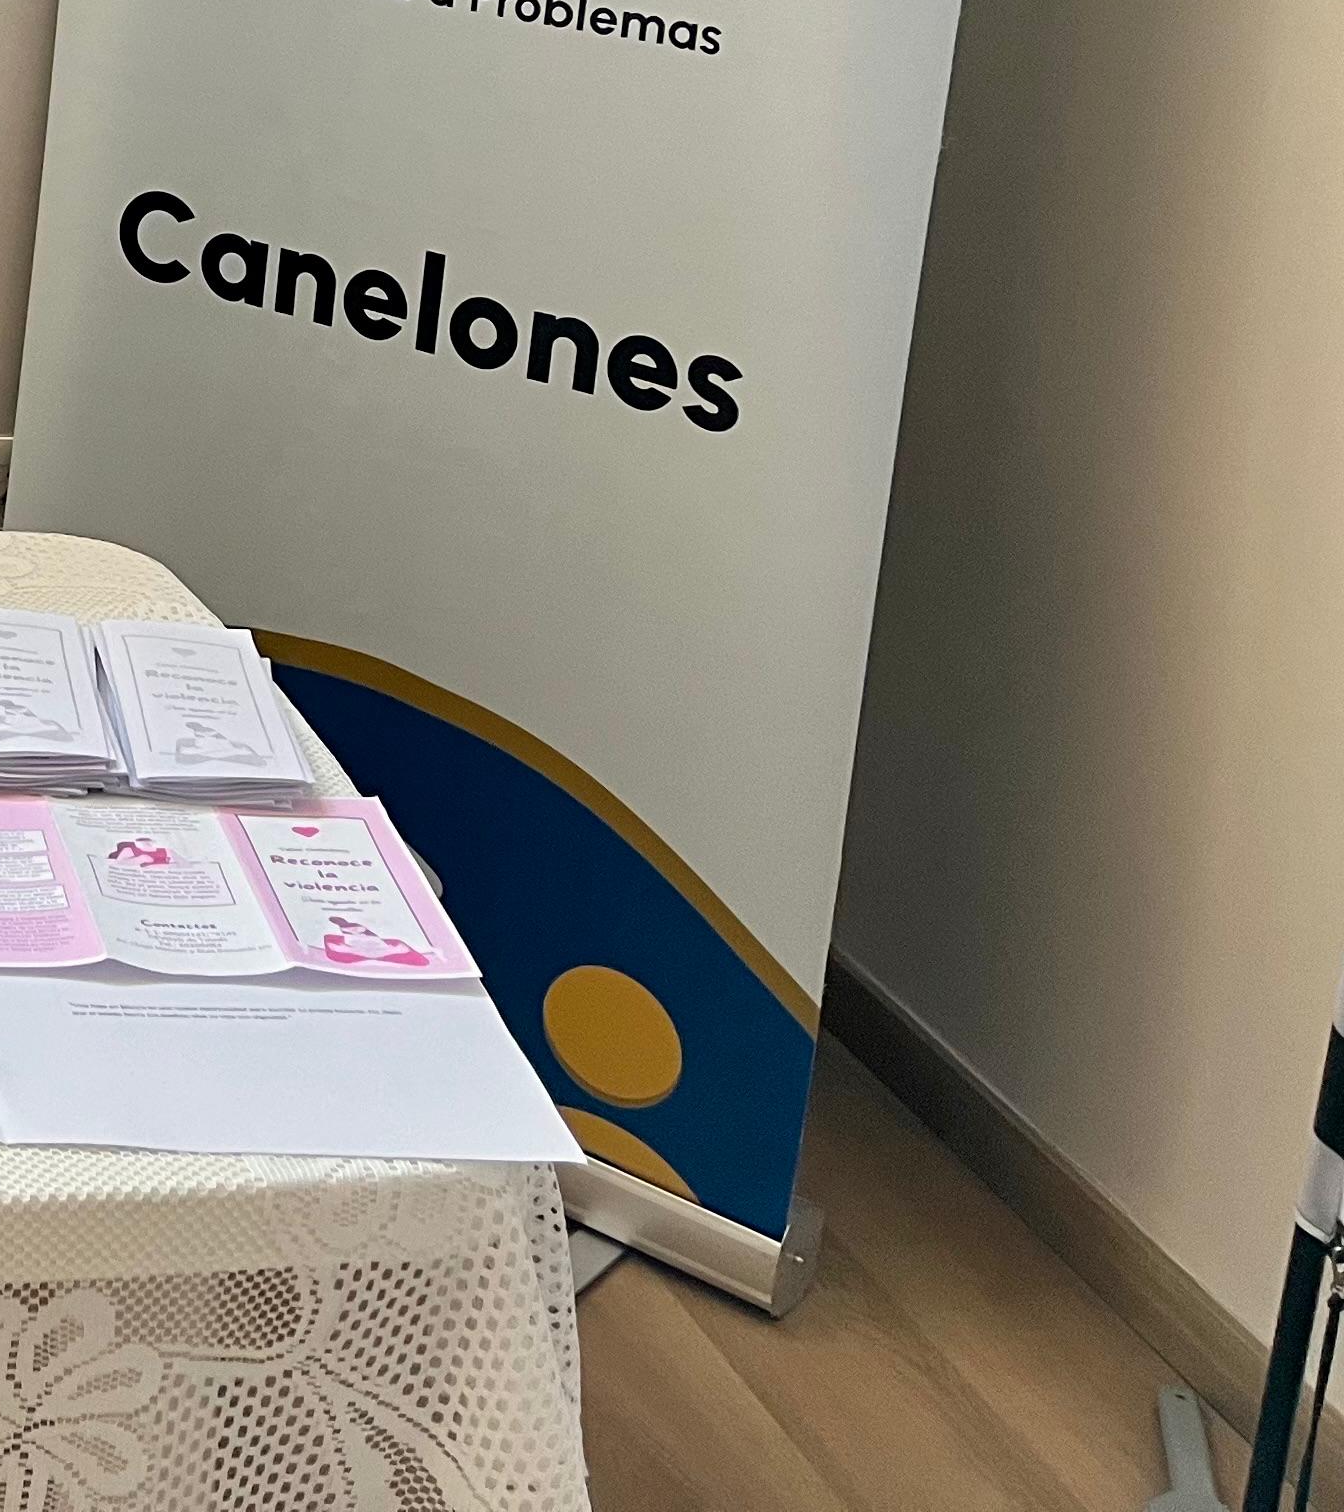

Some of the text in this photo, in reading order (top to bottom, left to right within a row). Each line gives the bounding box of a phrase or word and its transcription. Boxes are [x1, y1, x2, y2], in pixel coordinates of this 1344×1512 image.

[119, 190, 744, 433] Canelones
[269, 855, 373, 867] Reconoce
[317, 869, 338, 879] la
[284, 880, 380, 892] violencia
